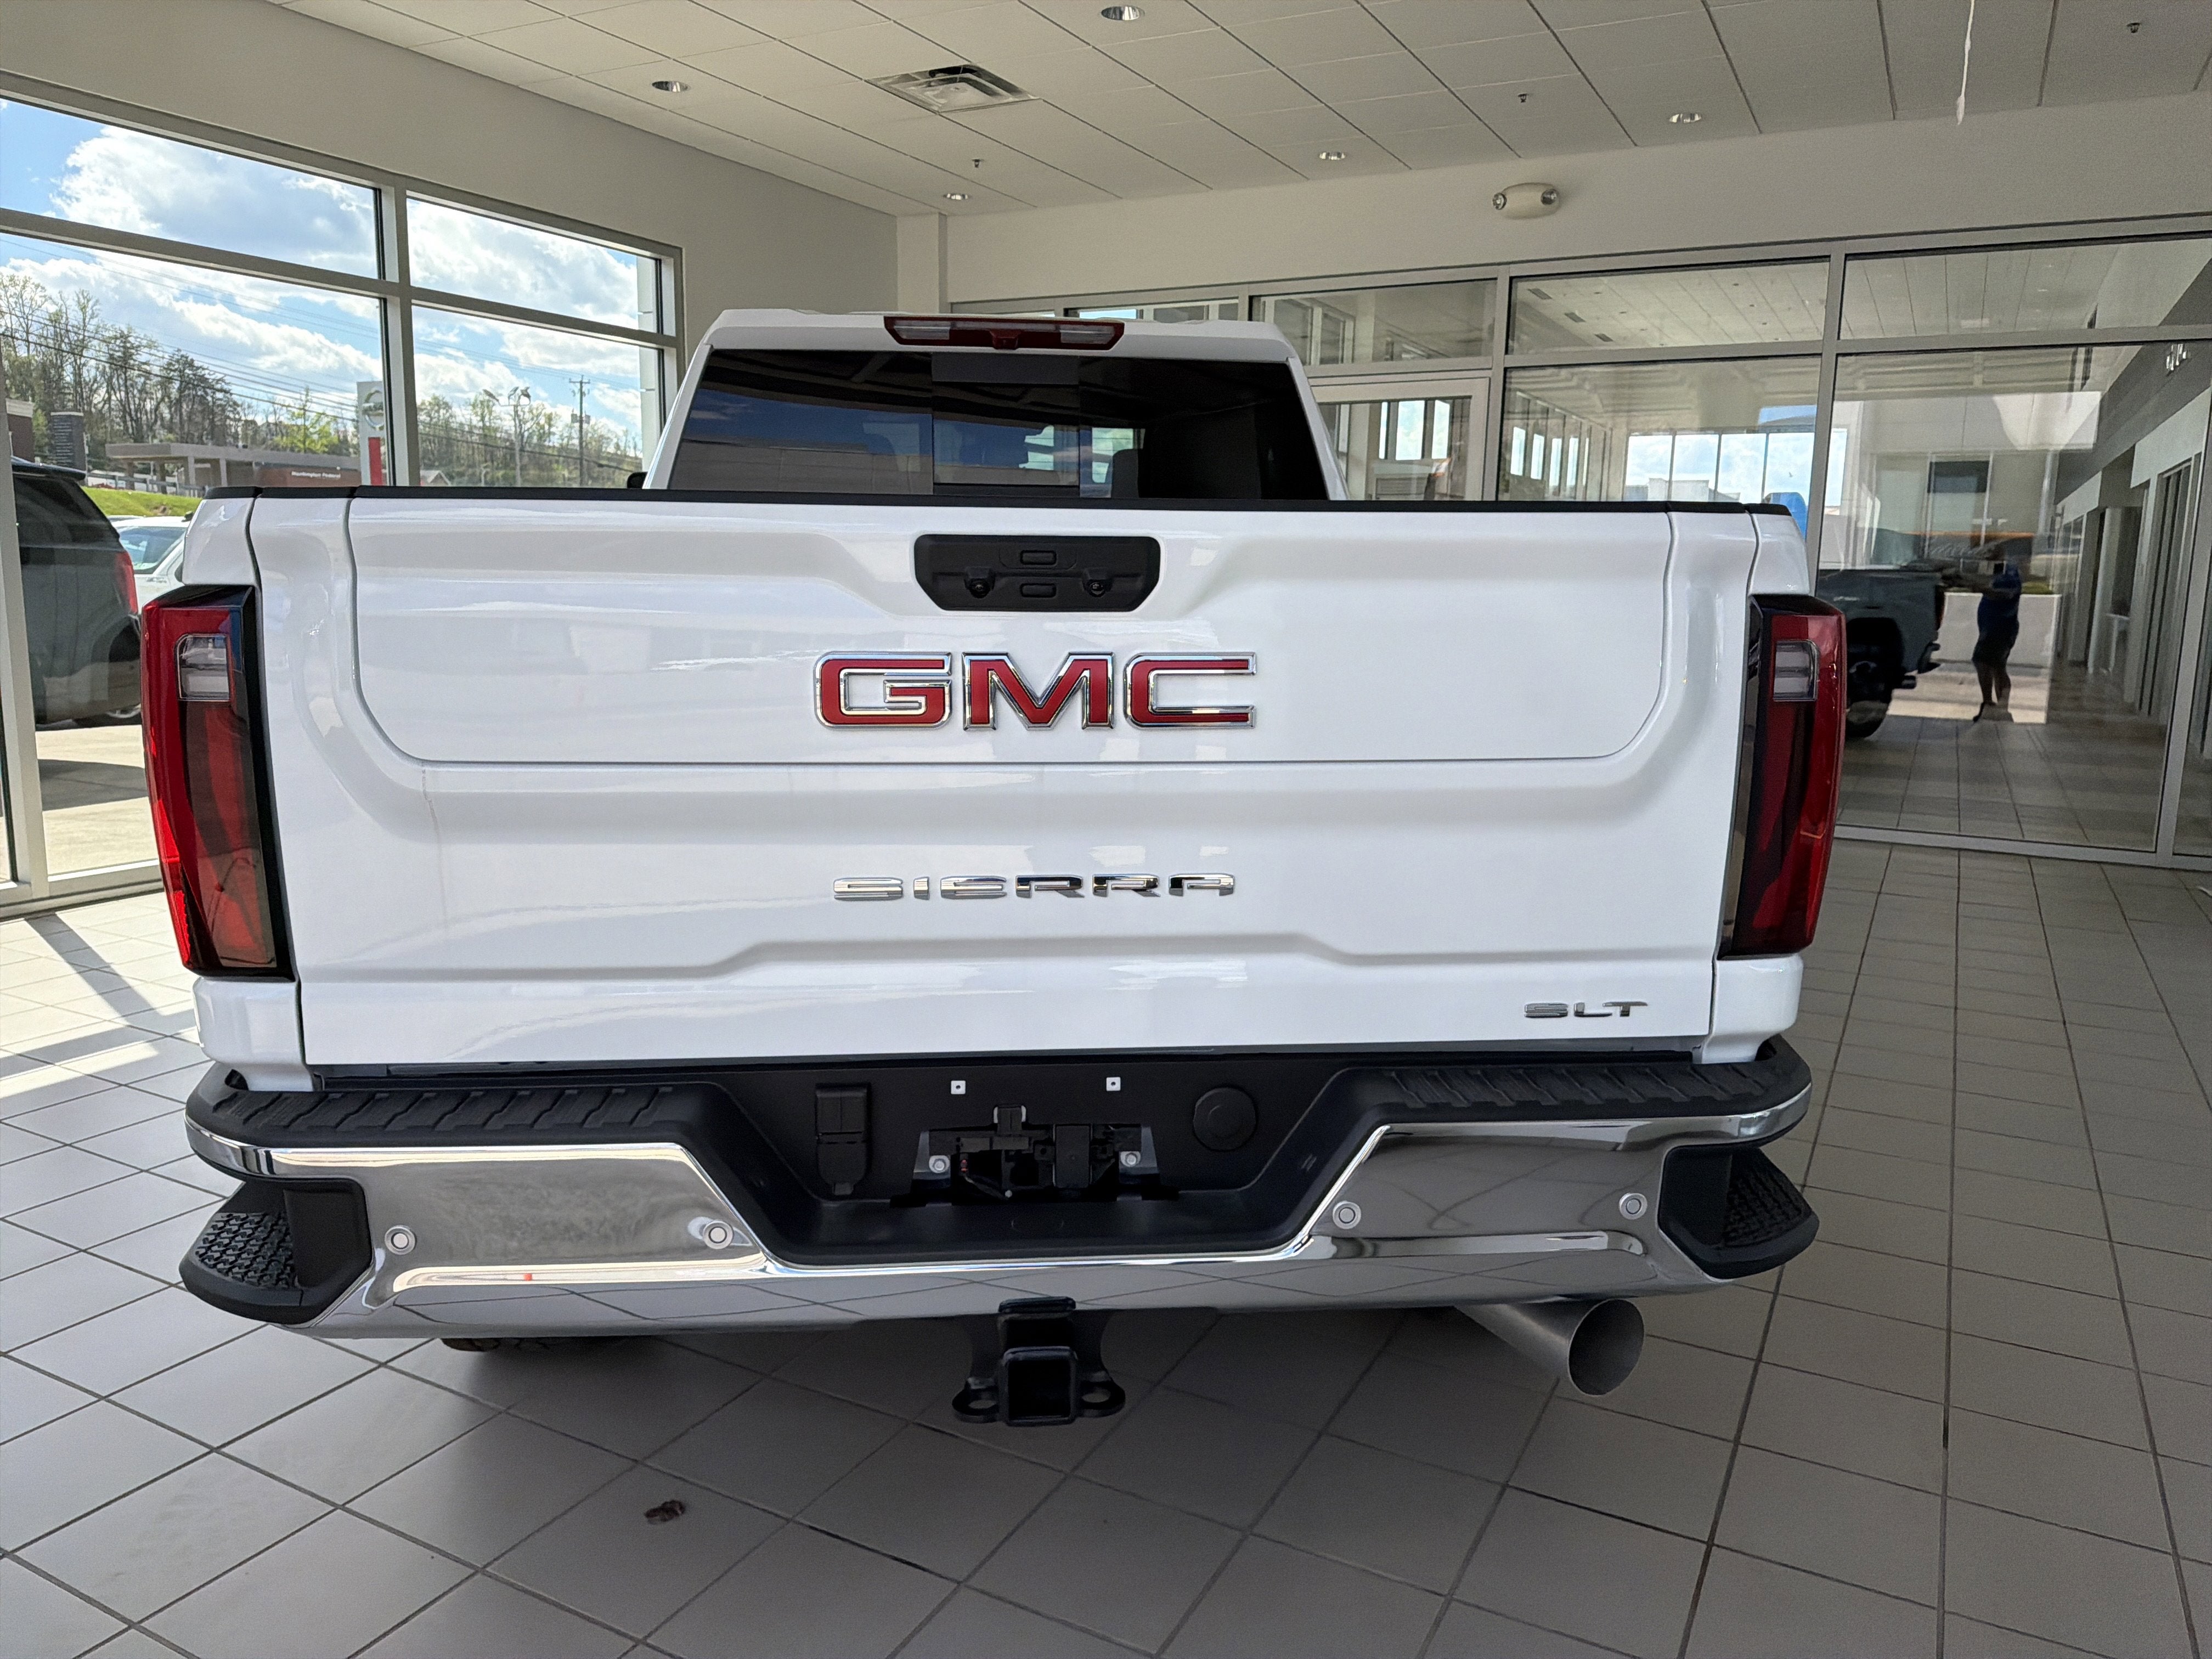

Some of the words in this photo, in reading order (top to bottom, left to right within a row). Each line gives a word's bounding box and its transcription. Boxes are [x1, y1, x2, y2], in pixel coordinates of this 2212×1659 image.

[814, 652, 1257, 731] GMC
[833, 873, 1235, 901] SIERRA
[1524, 1001, 1648, 1018] SLT
